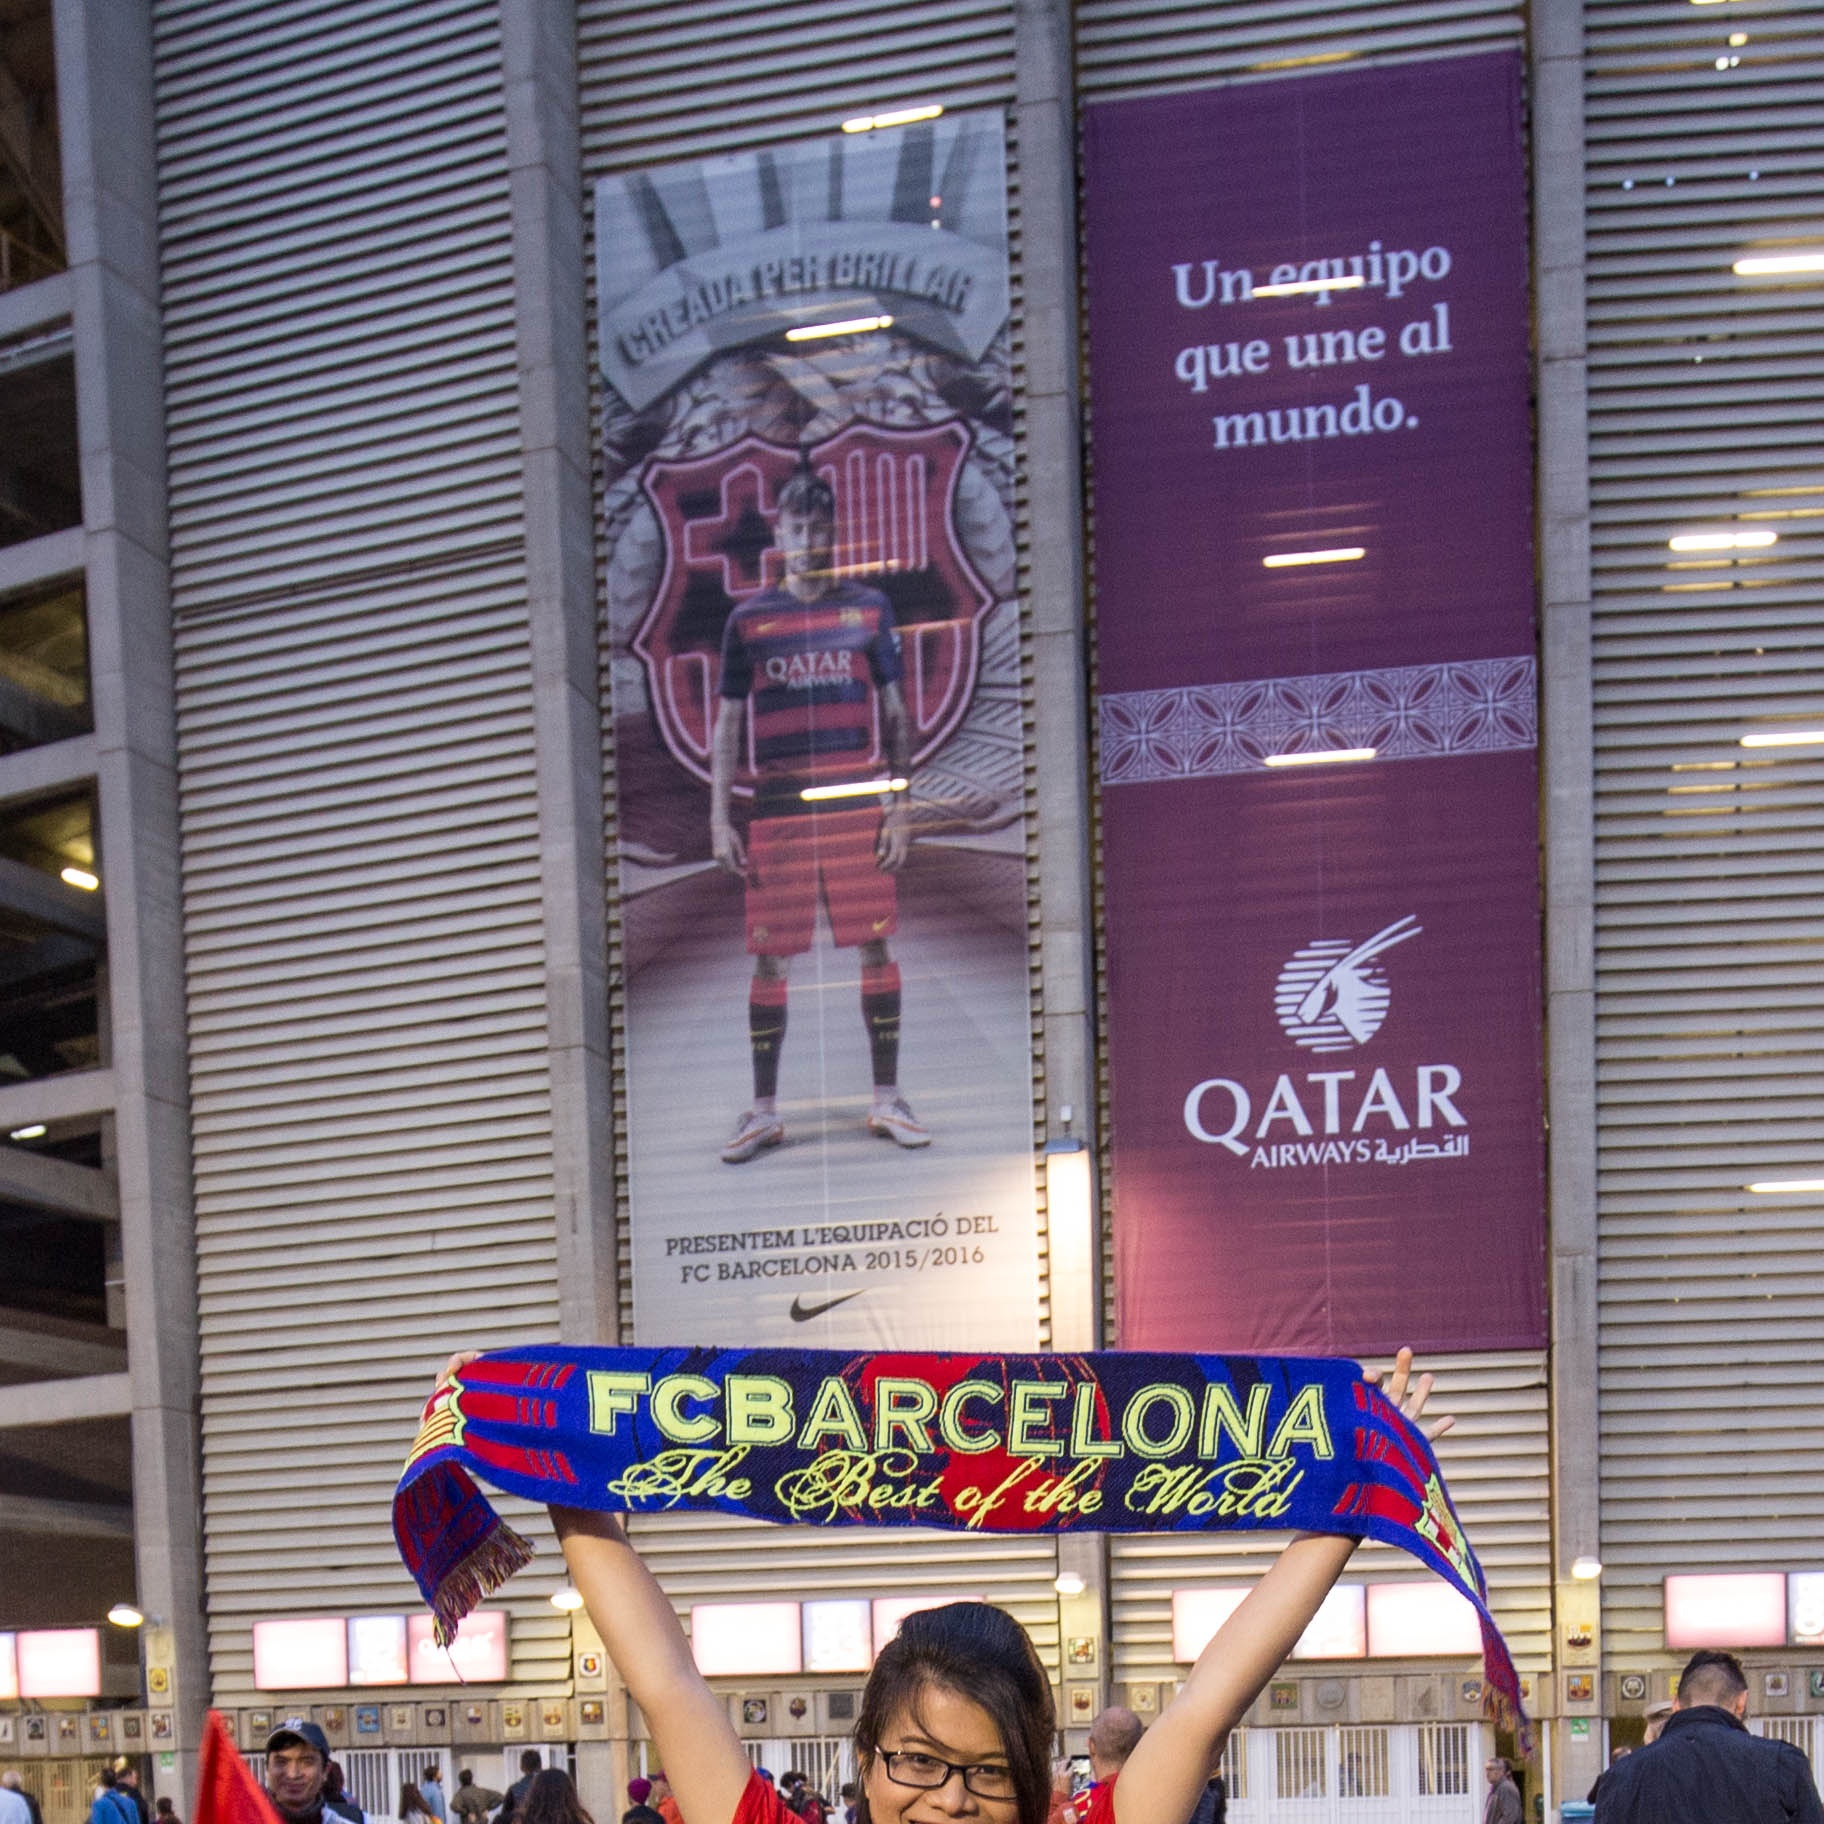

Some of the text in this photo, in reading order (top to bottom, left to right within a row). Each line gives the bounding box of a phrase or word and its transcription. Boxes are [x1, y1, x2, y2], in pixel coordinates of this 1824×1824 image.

[1171, 240, 1453, 309] Un equipo
[1175, 302, 1453, 393] que une al
[1212, 383, 1420, 450] mundo.
[765, 649, 853, 683] QATAR
[1183, 1063, 1469, 1157] QATAR
[1250, 1138, 1371, 1169] AIRWAYS
[1375, 1134, 1470, 1166] القطرية
[664, 1211, 1000, 1257] PRESENTEM L'EQUIPACIÓ DEL
[680, 1245, 986, 1285] FC BARCELONA 2015/2016
[607, 1444, 1305, 1529] The Best of the World
